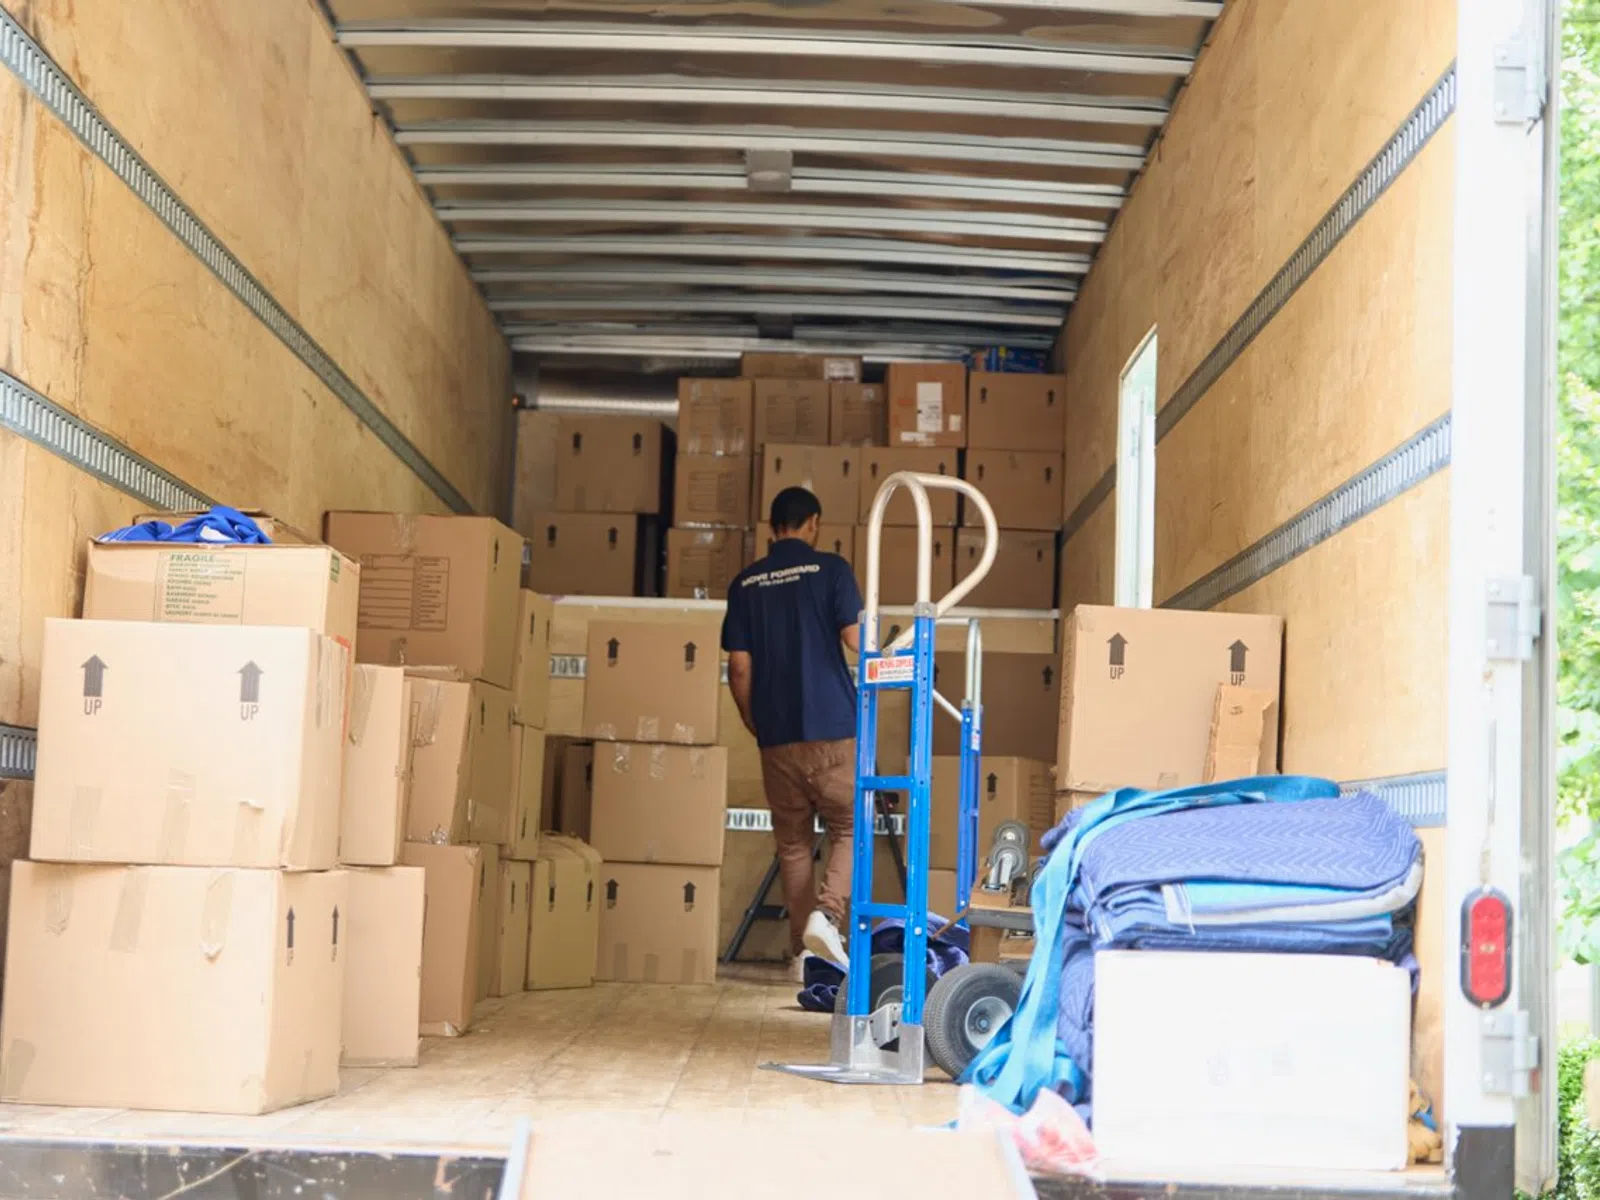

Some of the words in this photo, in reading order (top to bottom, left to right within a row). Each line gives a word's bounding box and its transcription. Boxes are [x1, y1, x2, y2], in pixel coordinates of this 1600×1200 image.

[171, 554, 214, 562] FRAGILE
[742, 572, 768, 587] MOVE
[770, 564, 820, 579] FORWARD
[1110, 667, 1125, 679] UP
[1231, 673, 1246, 686] UP
[84, 699, 102, 715] UP
[240, 704, 259, 721] UP
